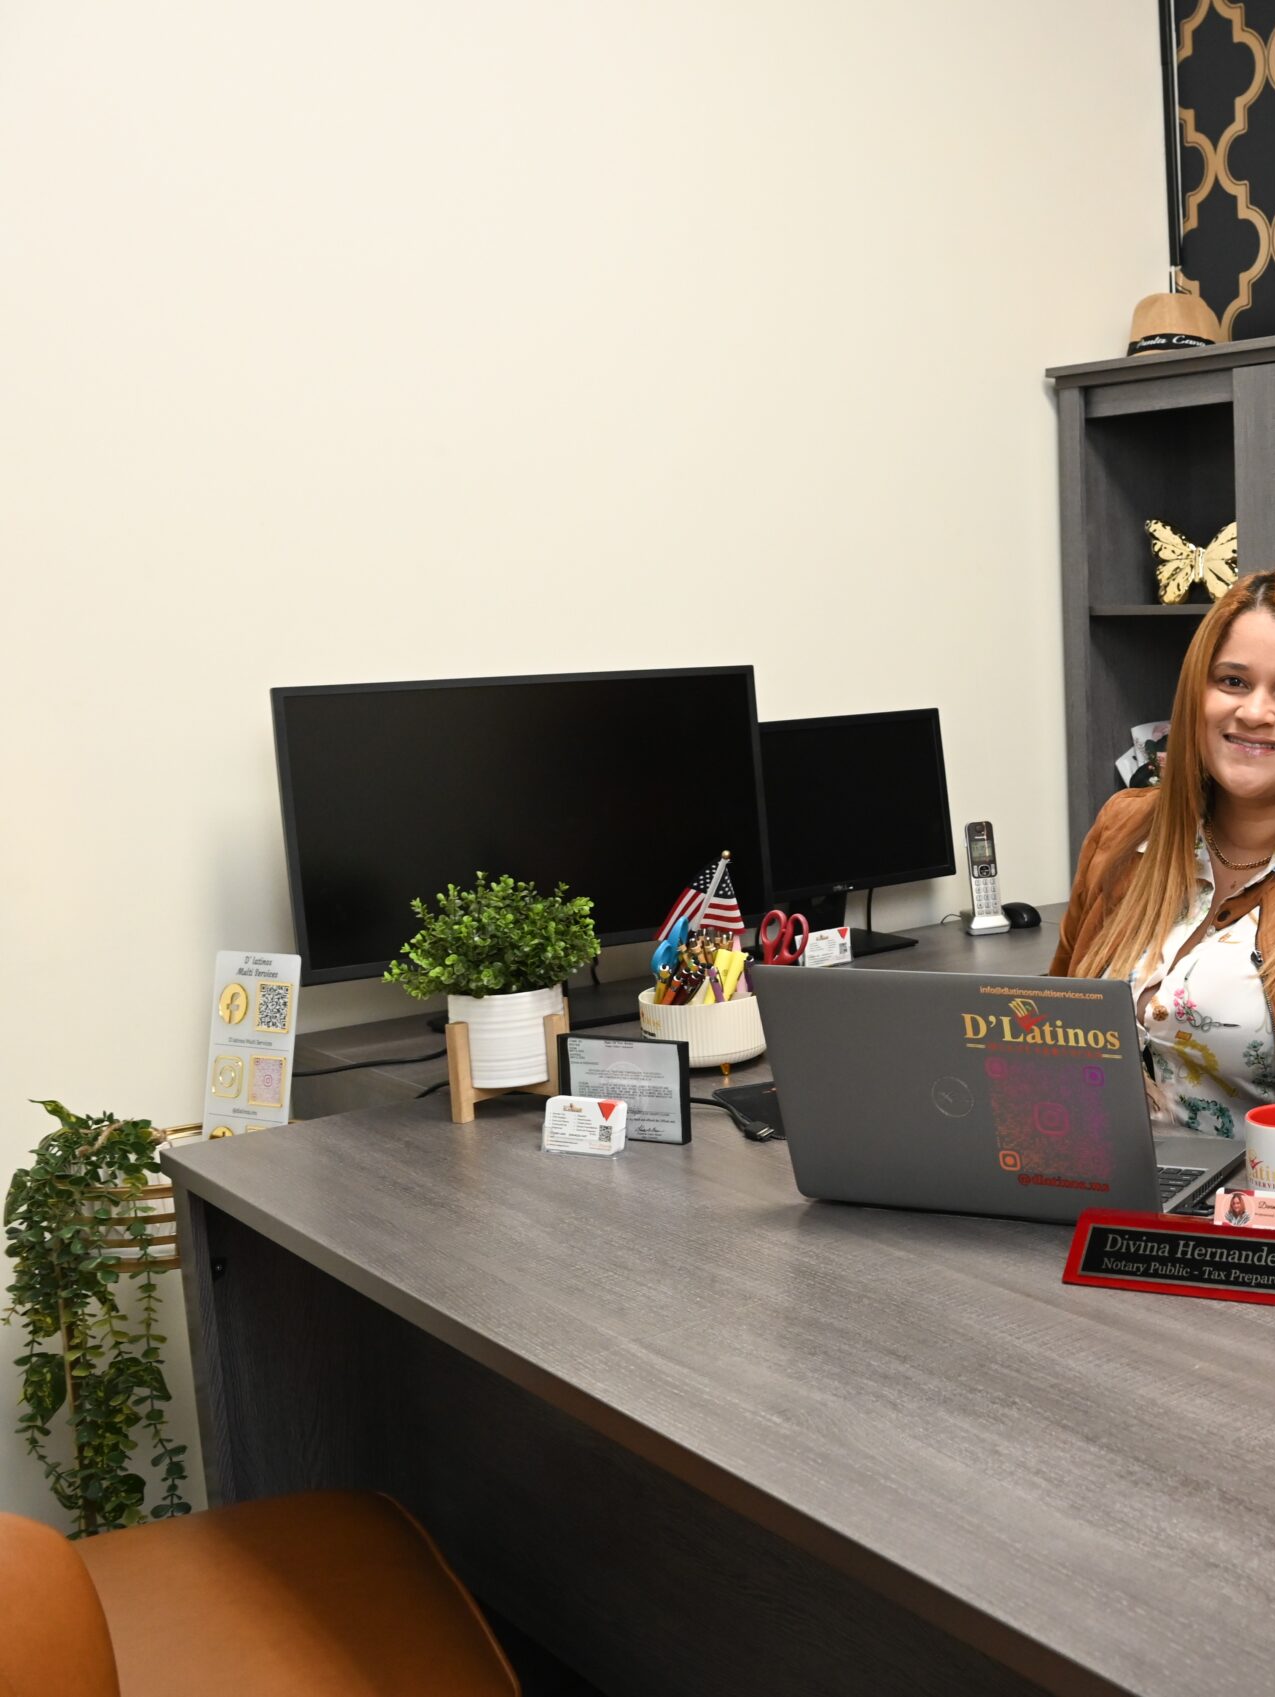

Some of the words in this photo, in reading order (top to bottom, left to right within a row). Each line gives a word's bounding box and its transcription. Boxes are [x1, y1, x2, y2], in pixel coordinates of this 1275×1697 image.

[961, 1013, 1121, 1049] D'Latinos
[1104, 1233, 1169, 1257] Divina
[1102, 1257, 1147, 1275] Notary
[1149, 1262, 1190, 1277] Public
[1202, 1266, 1226, 1281] Tax
